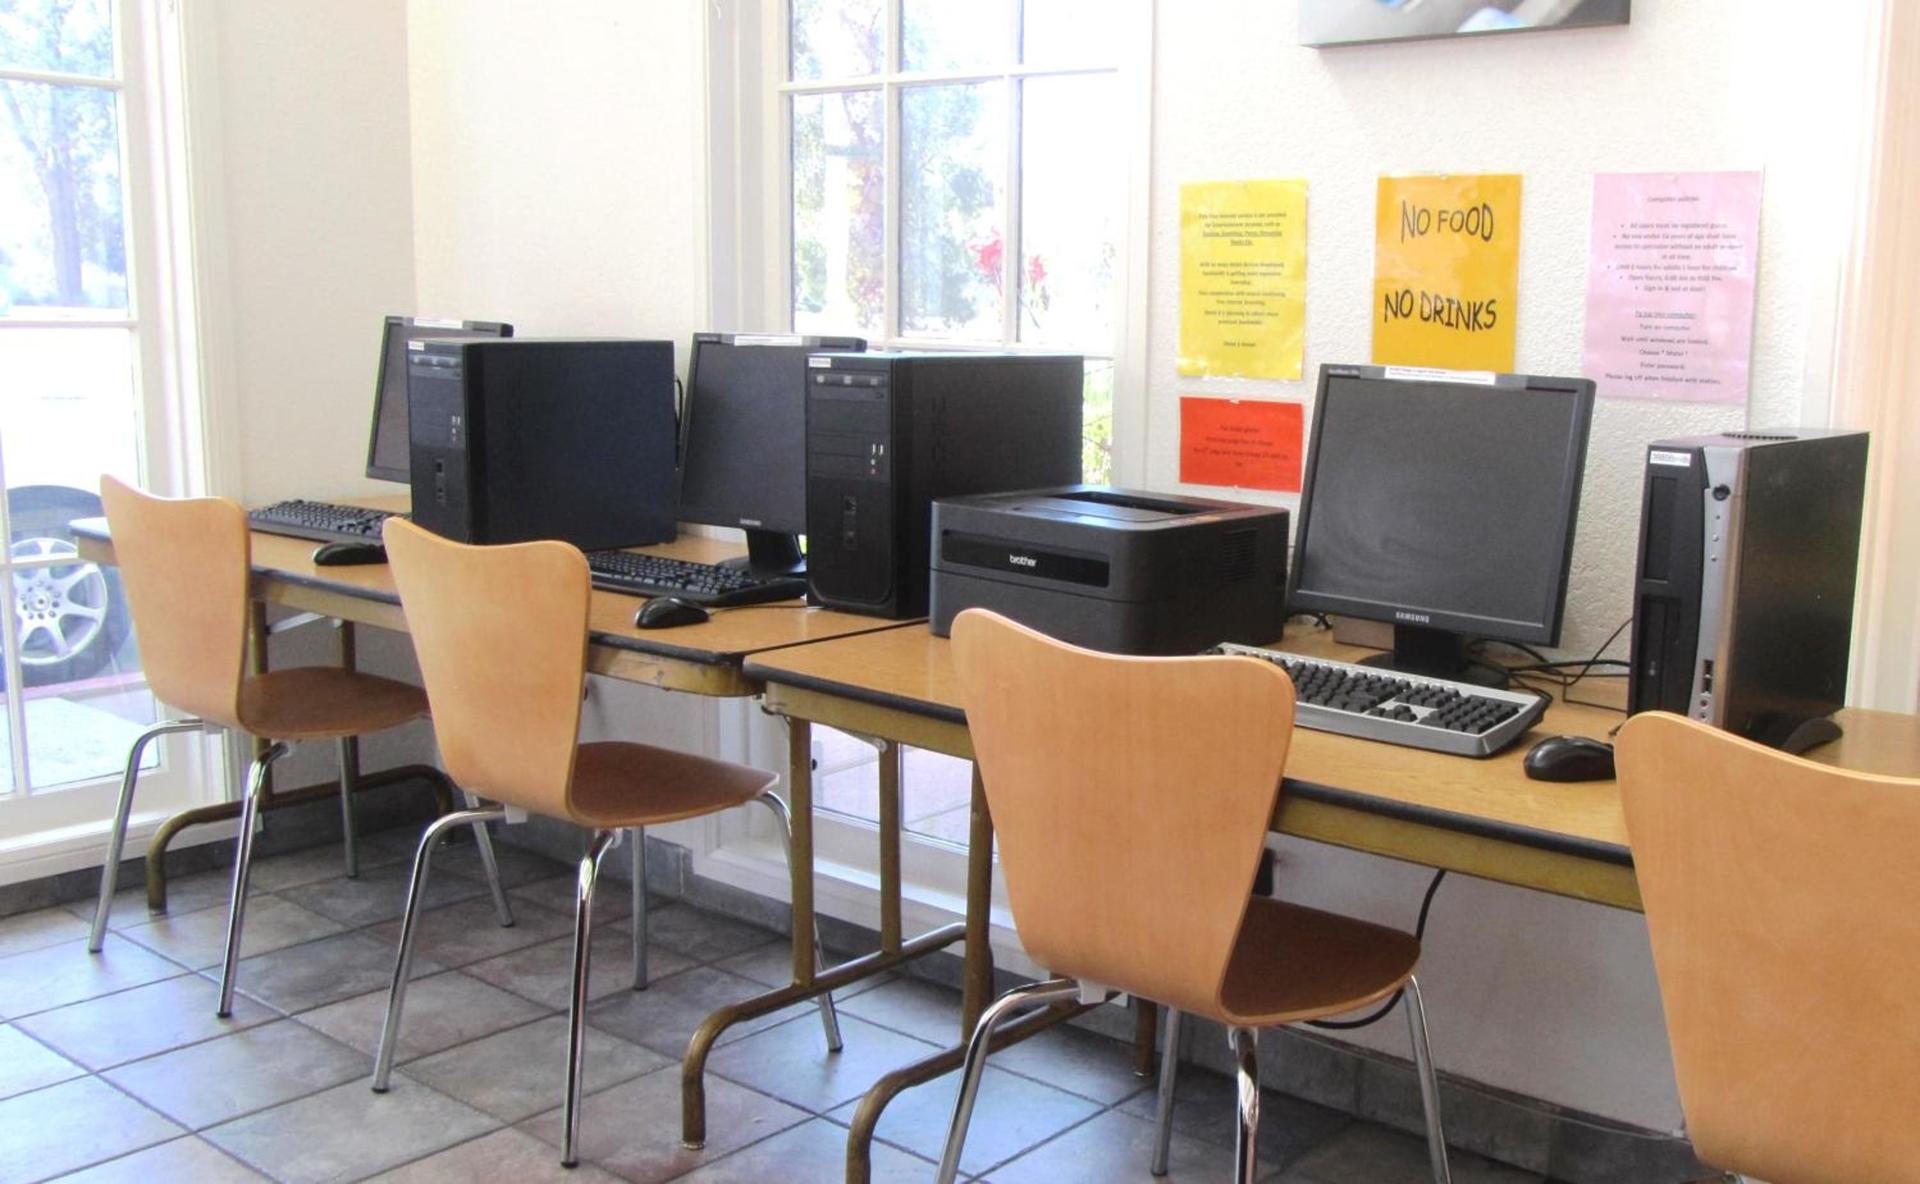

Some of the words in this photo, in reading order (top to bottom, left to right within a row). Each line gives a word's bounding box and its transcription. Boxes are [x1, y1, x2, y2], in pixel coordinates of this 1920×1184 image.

[1401, 200, 1431, 244] NO
[1437, 203, 1494, 242] FOOD
[1384, 289, 1414, 323] NO
[1420, 290, 1497, 332] DRINKS
[1009, 554, 1037, 567] brother
